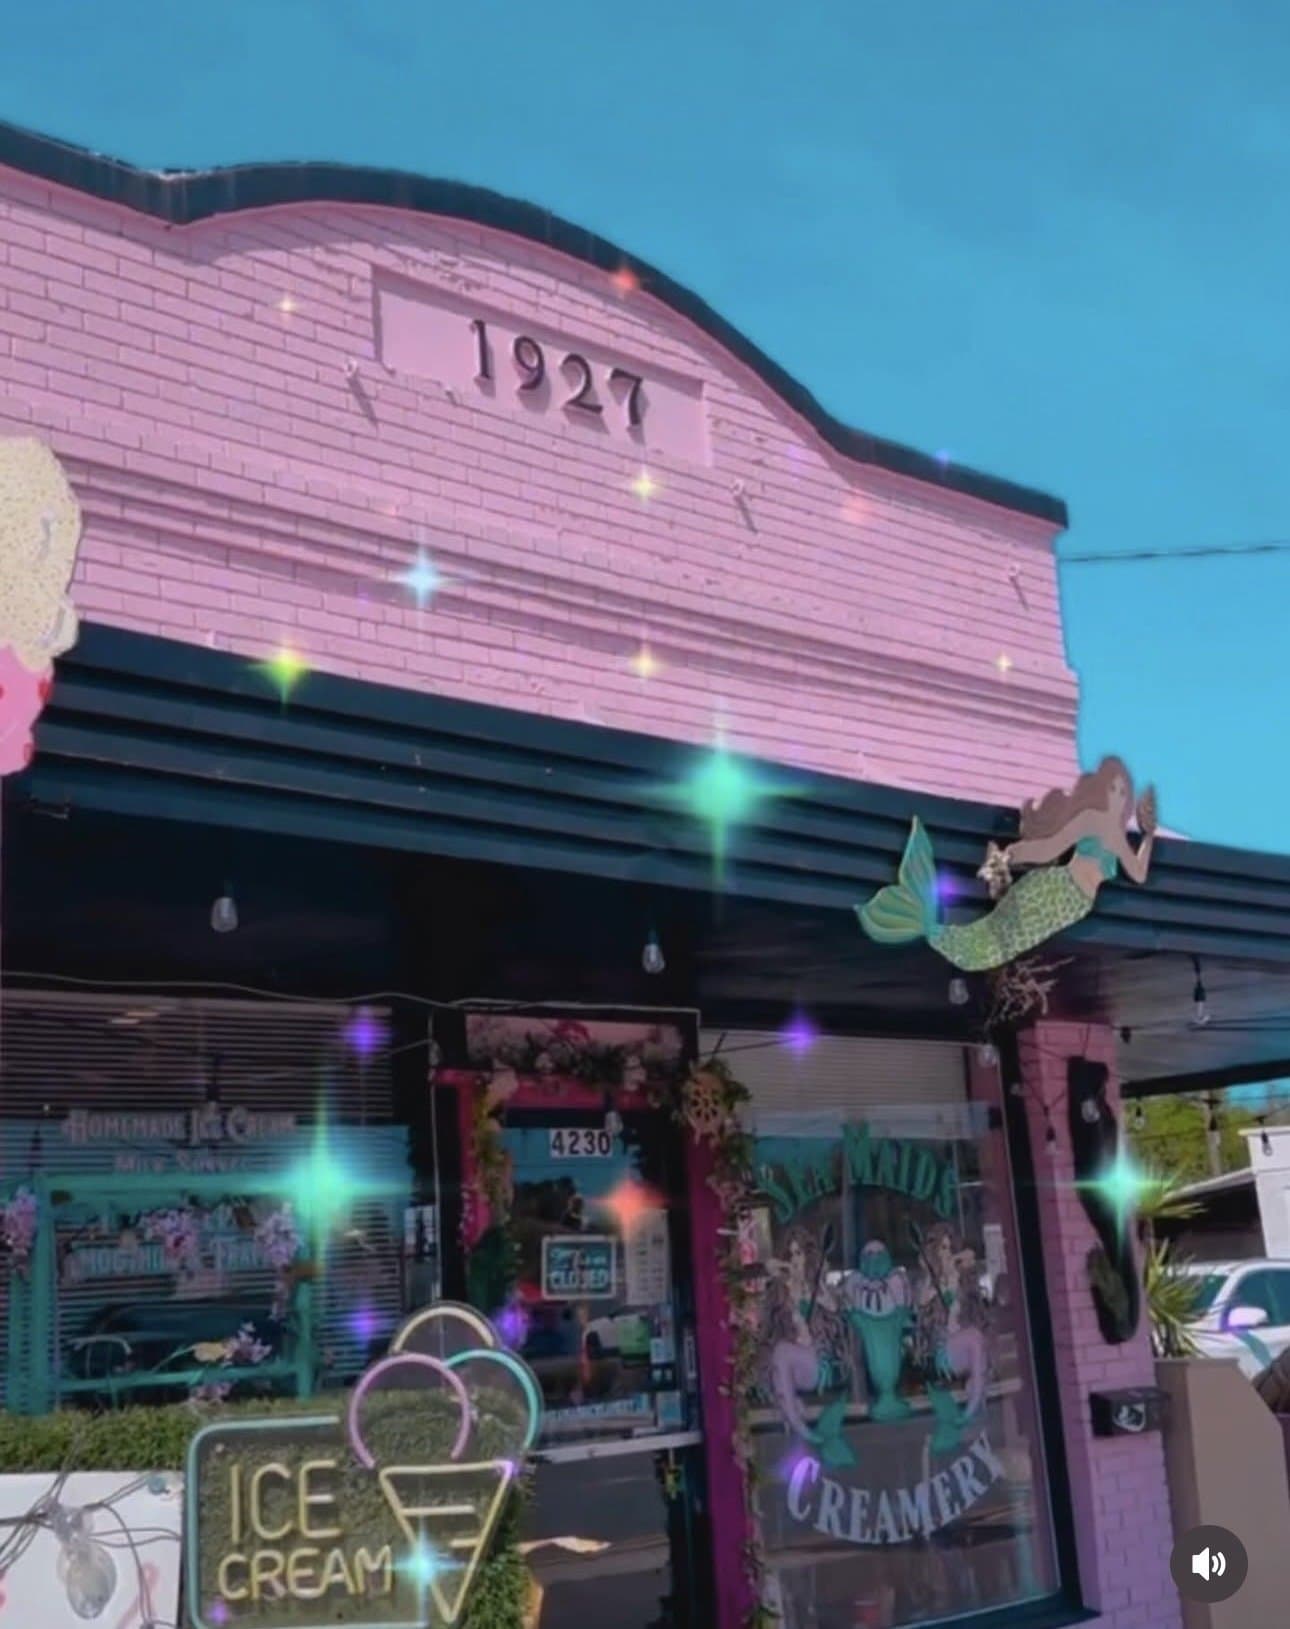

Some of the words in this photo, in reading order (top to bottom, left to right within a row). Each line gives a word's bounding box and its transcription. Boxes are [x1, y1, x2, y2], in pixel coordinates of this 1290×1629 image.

[470, 319, 643, 425] 1927
[551, 1130, 612, 1156] 4230
[229, 1458, 342, 1545] ICE
[787, 1431, 1005, 1546] CREAMERY
[217, 1545, 393, 1600] CREAM
